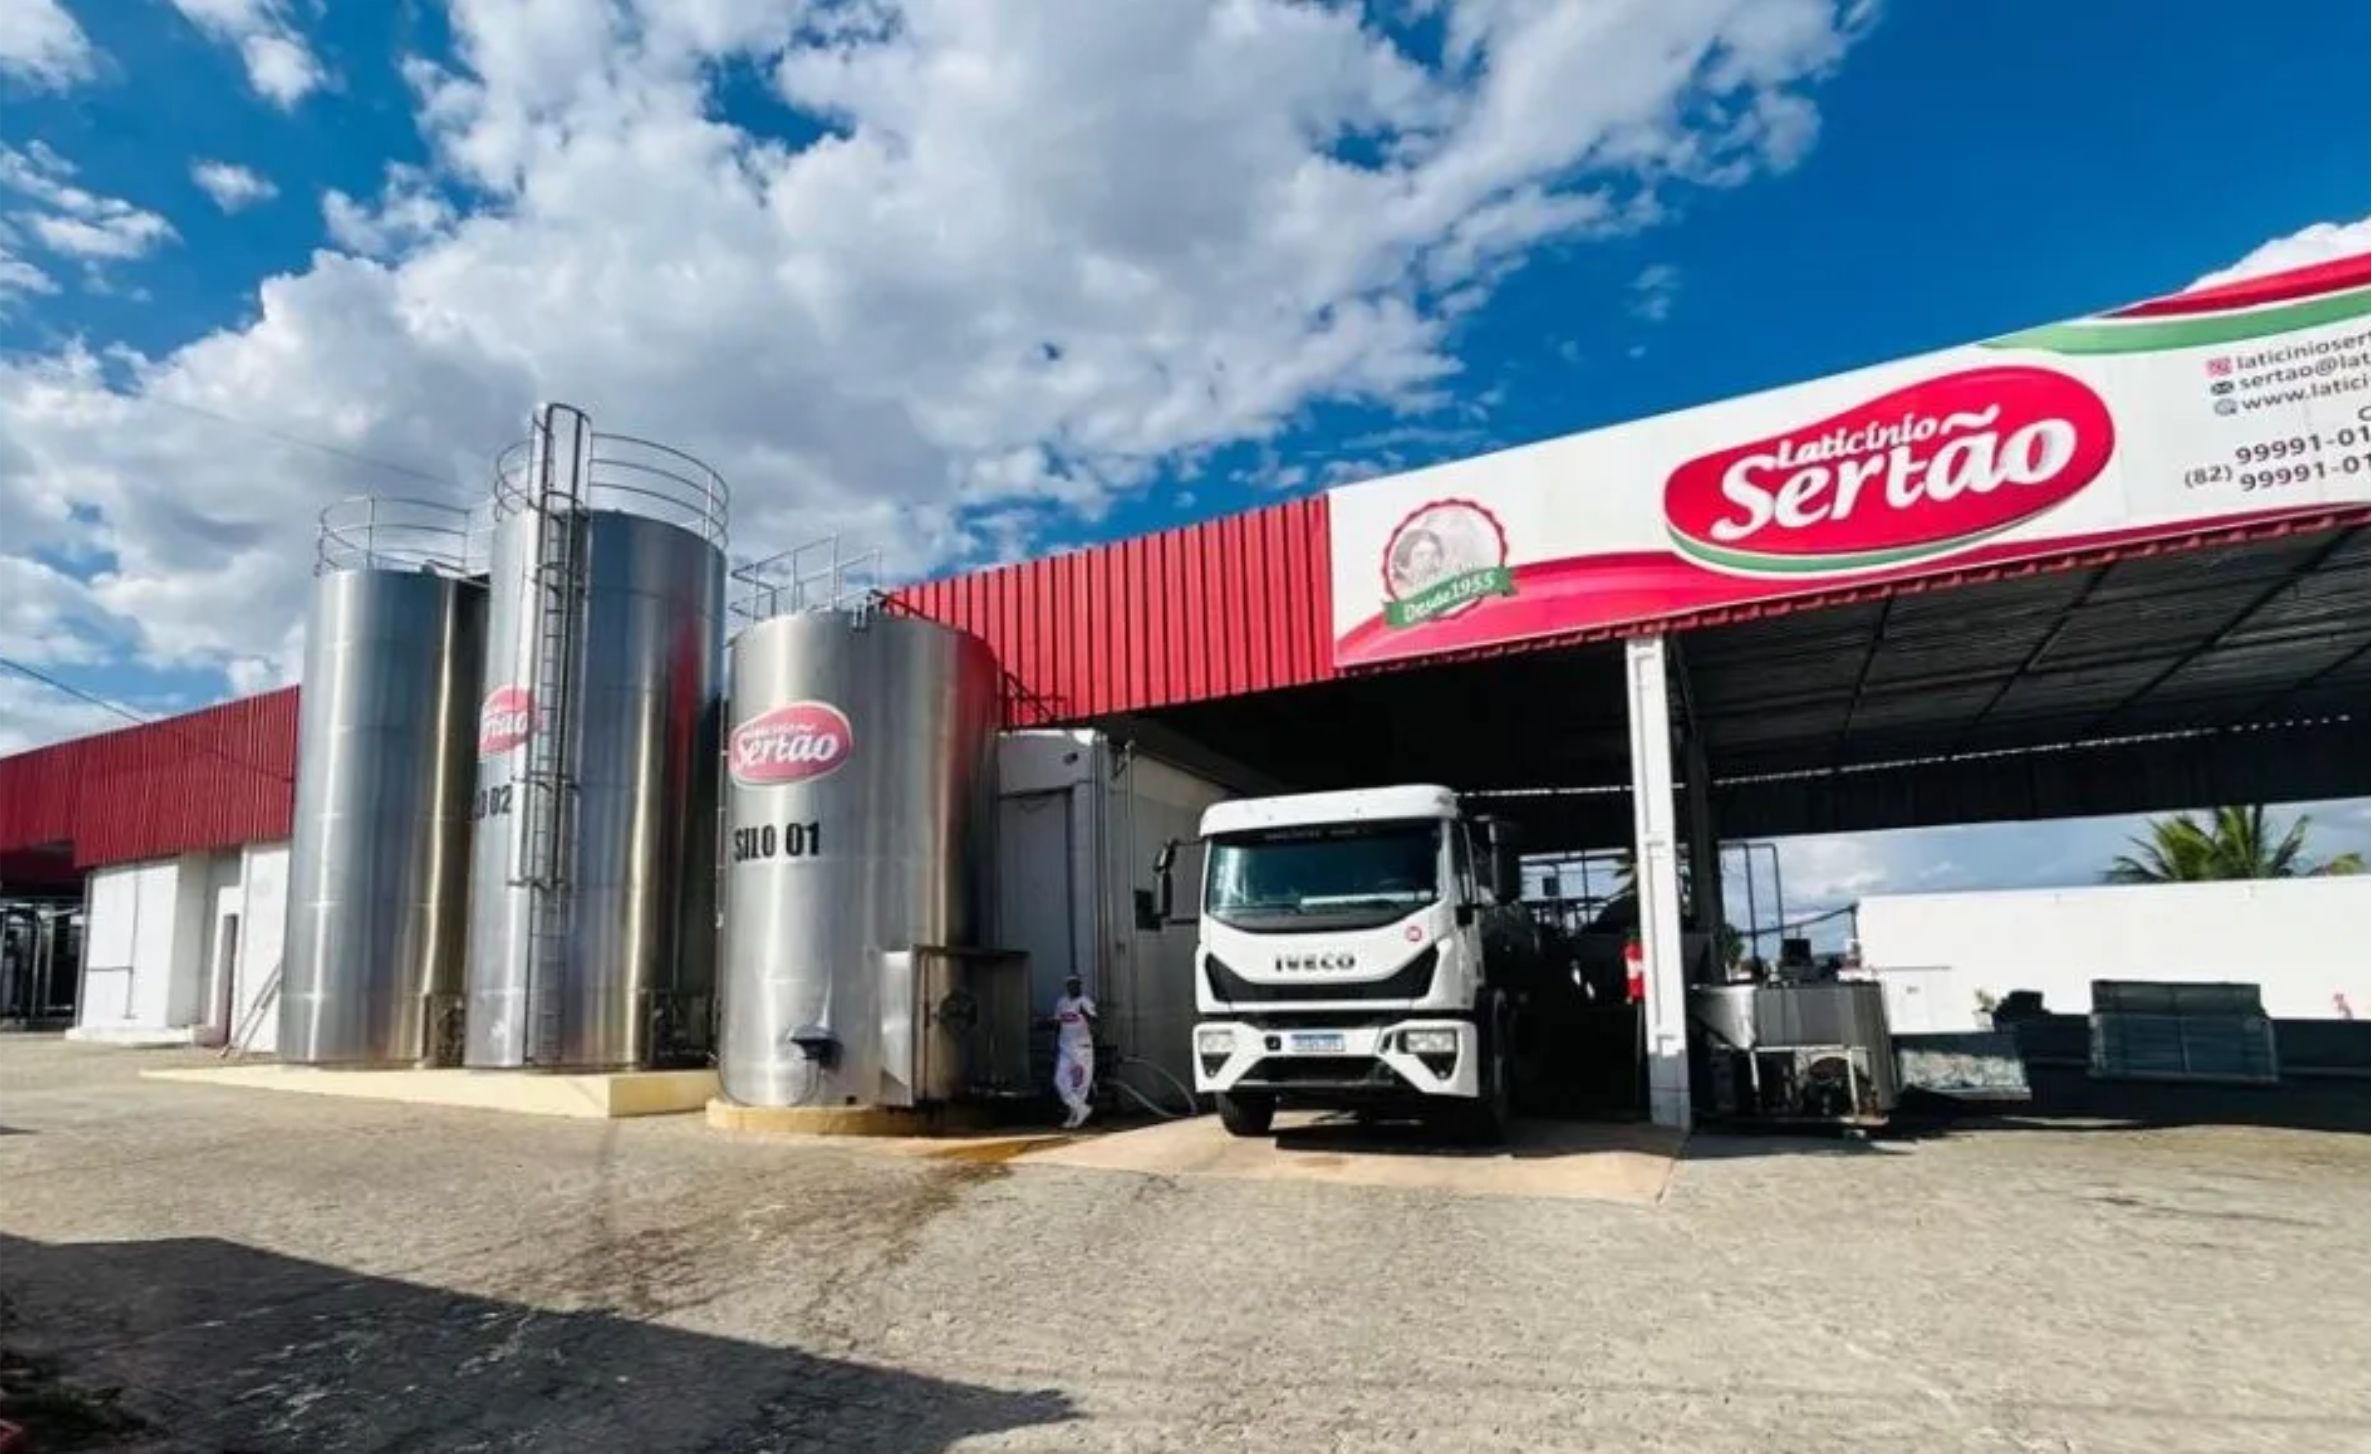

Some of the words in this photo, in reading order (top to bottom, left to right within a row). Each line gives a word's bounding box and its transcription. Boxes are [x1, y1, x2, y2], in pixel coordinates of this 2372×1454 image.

[1775, 411, 1938, 469] Laticínio
[1709, 402, 2077, 541] Sertão
[2184, 463, 2233, 490] (82)
[734, 824, 776, 863] SILO
[786, 821, 820, 857] 01
[1275, 953, 1356, 973] IVECO
